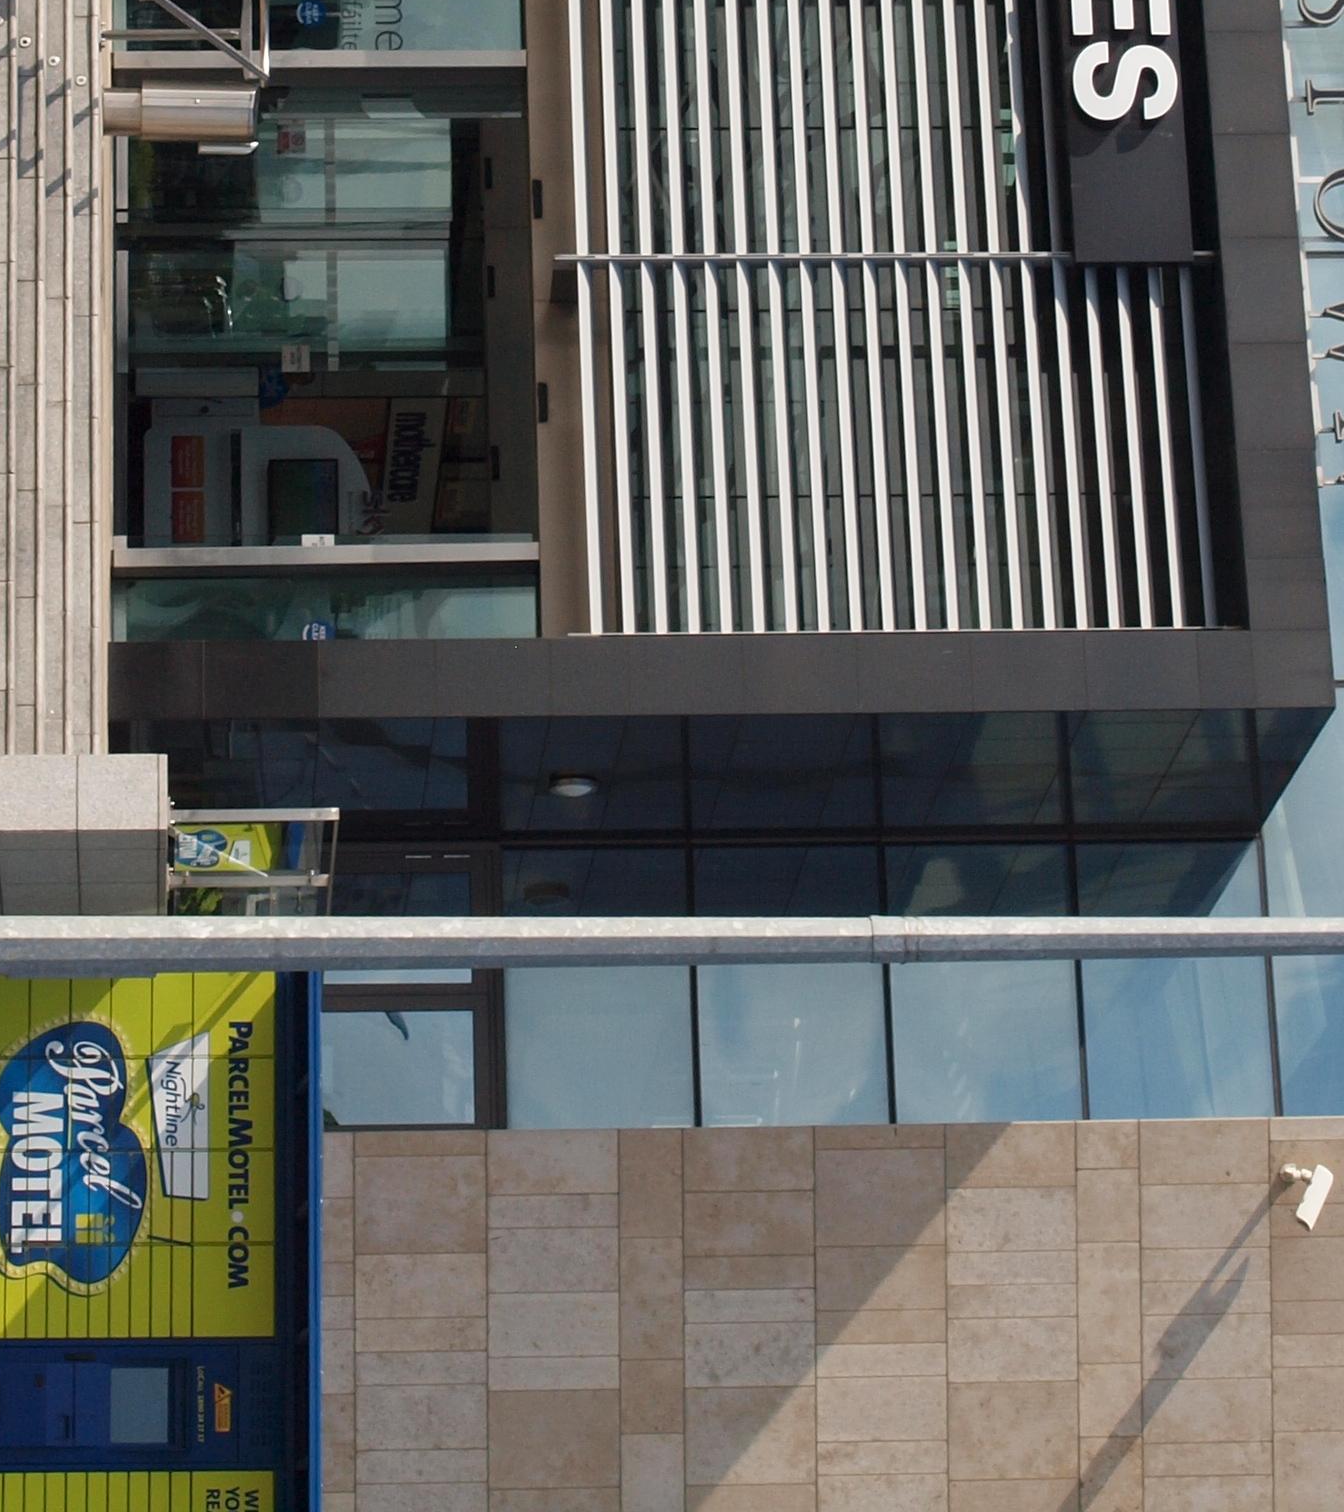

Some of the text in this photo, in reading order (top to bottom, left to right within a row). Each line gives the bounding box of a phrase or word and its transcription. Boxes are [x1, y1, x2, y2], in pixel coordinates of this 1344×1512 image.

[341, 1, 363, 50] fáilte
[388, 412, 436, 504] mothercare
[45, 1040, 143, 1208] Parcel
[161, 1061, 183, 1147] Nightline
[11, 1091, 64, 1253] MOTEL
[245, 1489, 260, 1512] W
